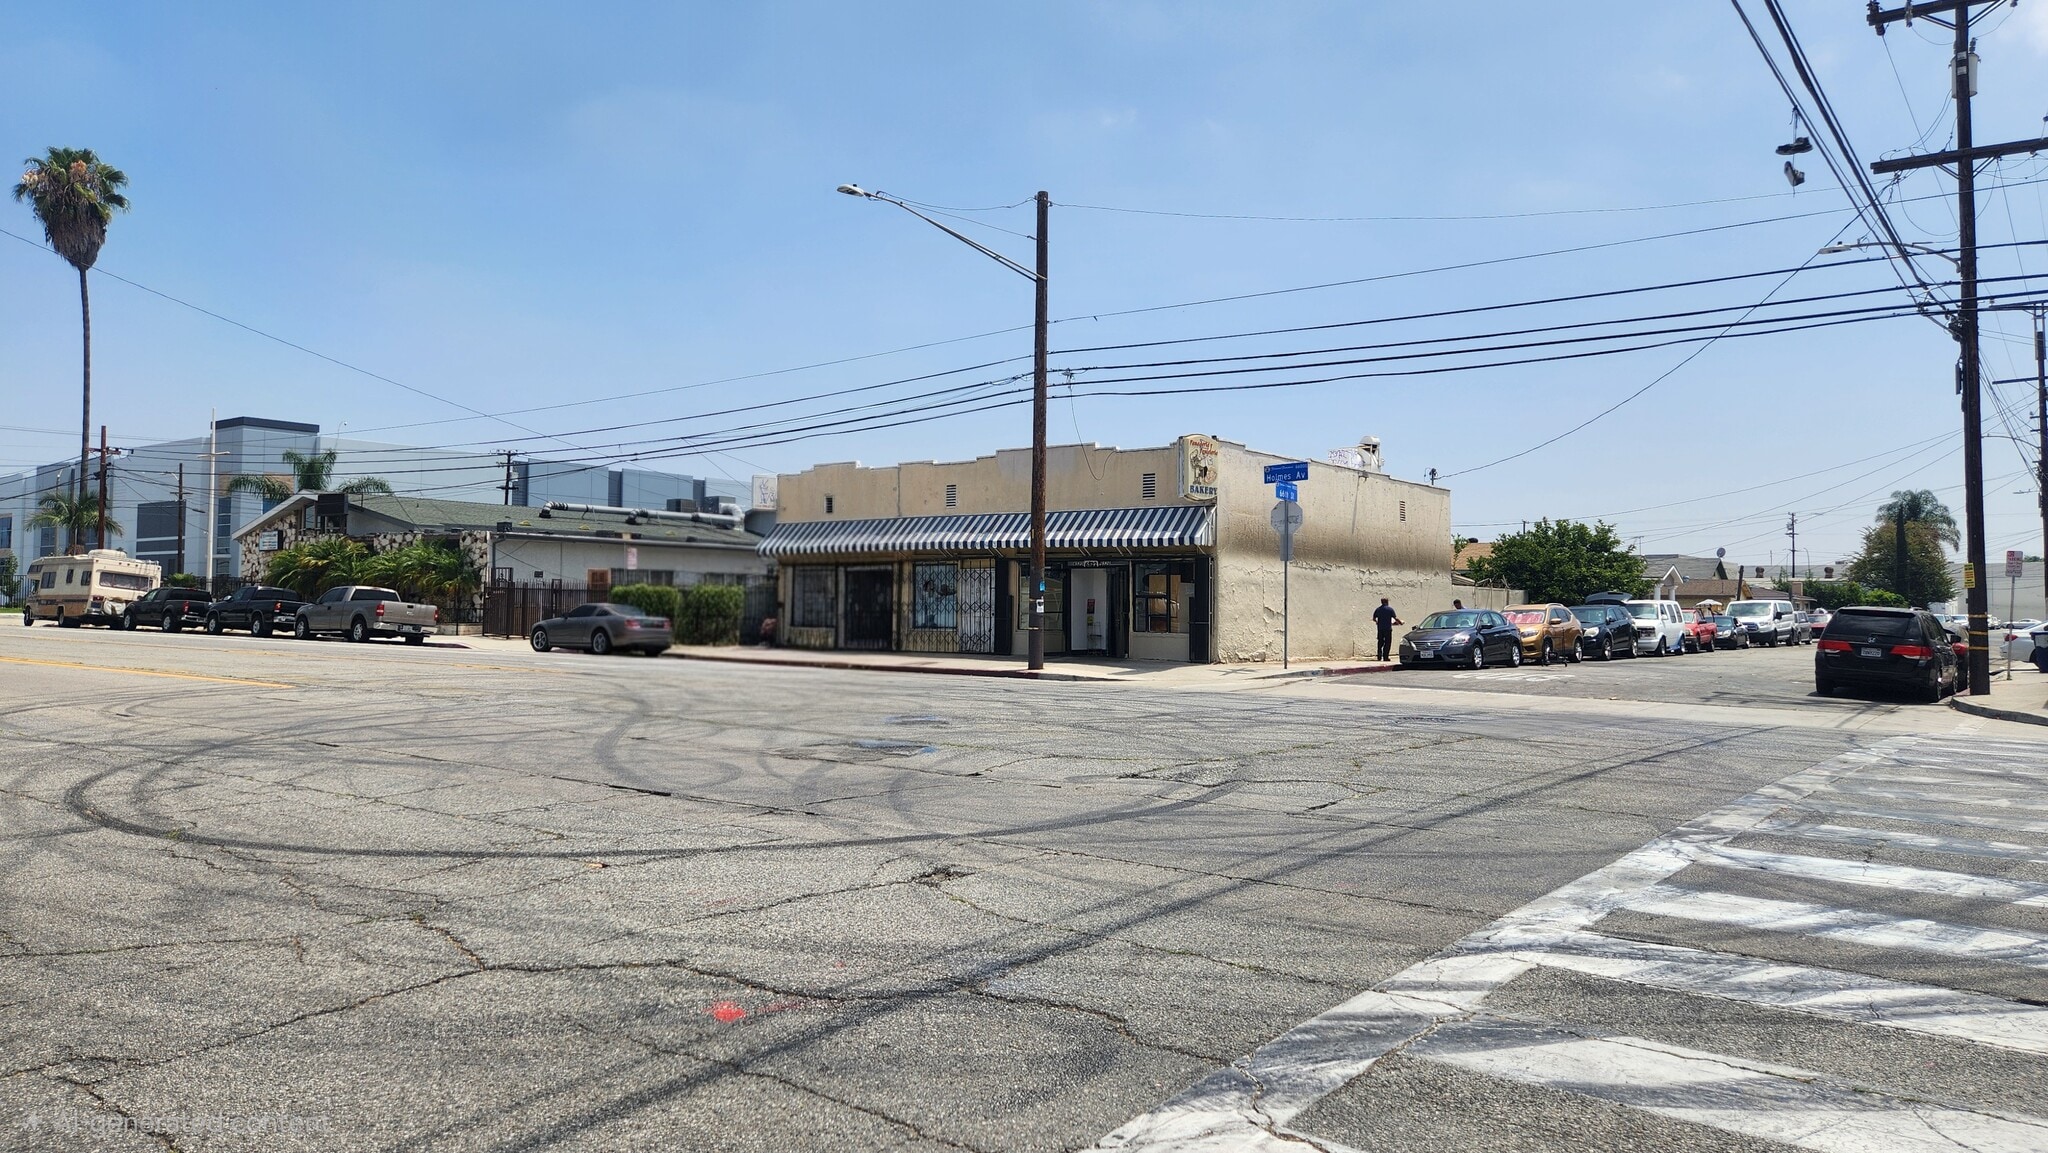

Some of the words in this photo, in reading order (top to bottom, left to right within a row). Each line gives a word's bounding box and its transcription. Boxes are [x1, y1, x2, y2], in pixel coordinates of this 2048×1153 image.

[1266, 472, 1292, 482] Holmes
[1295, 471, 1306, 480] Av
[1189, 484, 1218, 495] BAKERY
